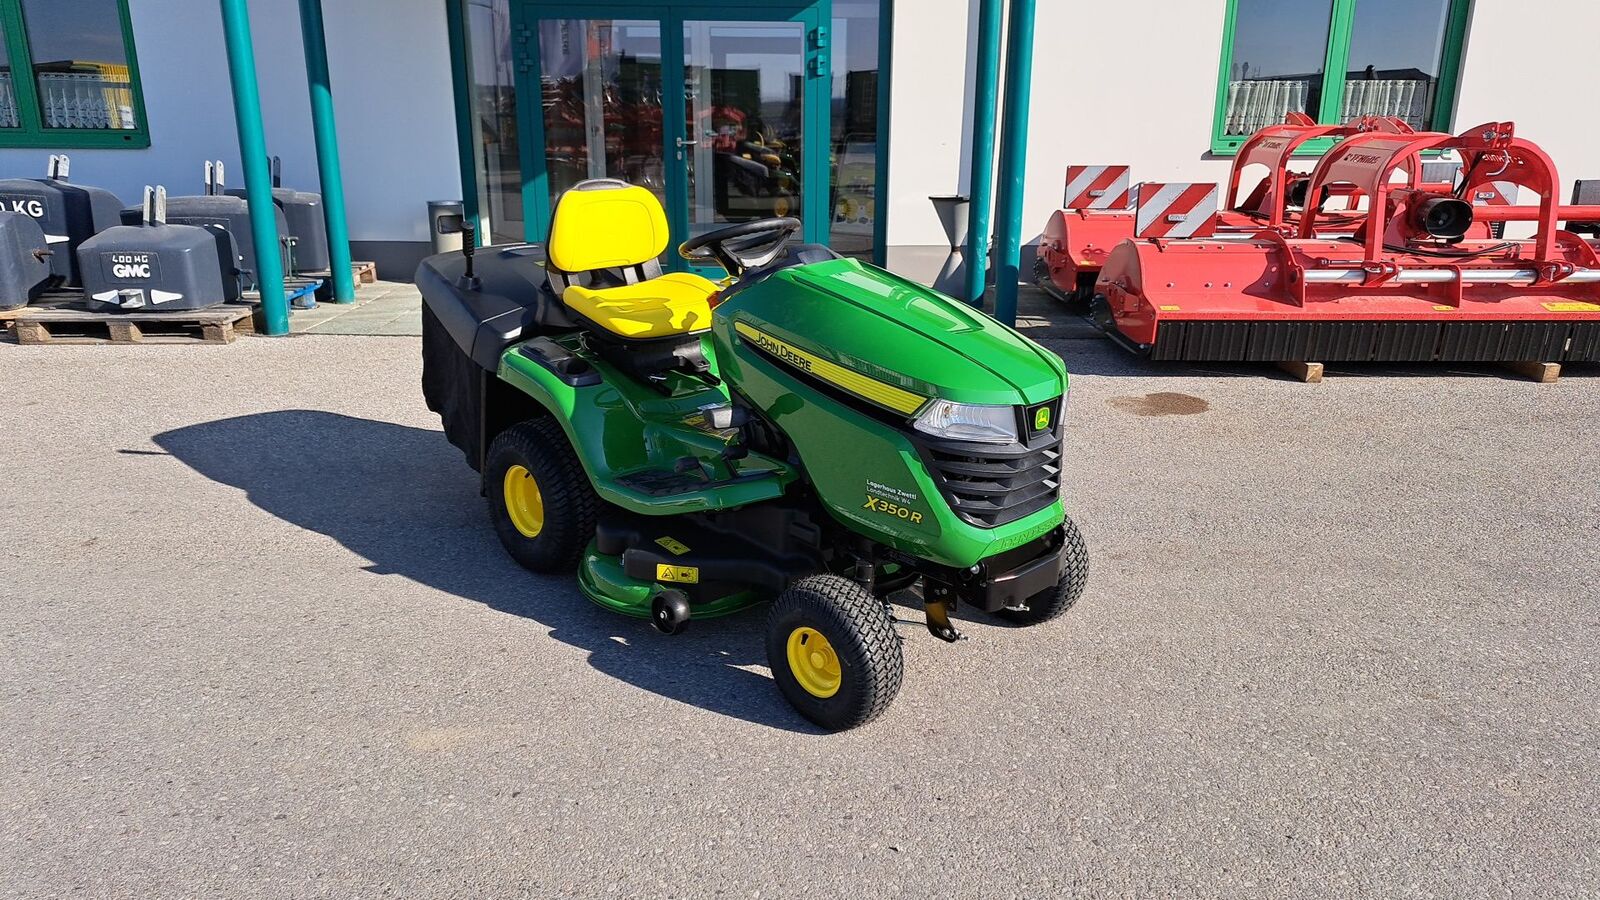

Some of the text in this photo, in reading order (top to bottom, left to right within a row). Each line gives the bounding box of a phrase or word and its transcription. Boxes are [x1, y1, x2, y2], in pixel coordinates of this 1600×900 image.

[12, 200, 44, 217] KG
[111, 255, 149, 263] 400 KG
[112, 264, 150, 278] GMC
[756, 332, 812, 371] JOHN DEERE
[866, 479, 917, 500] Lagerhaus Zwettl
[866, 485, 900, 501] Landtechnik
[863, 494, 923, 524] X350 R
